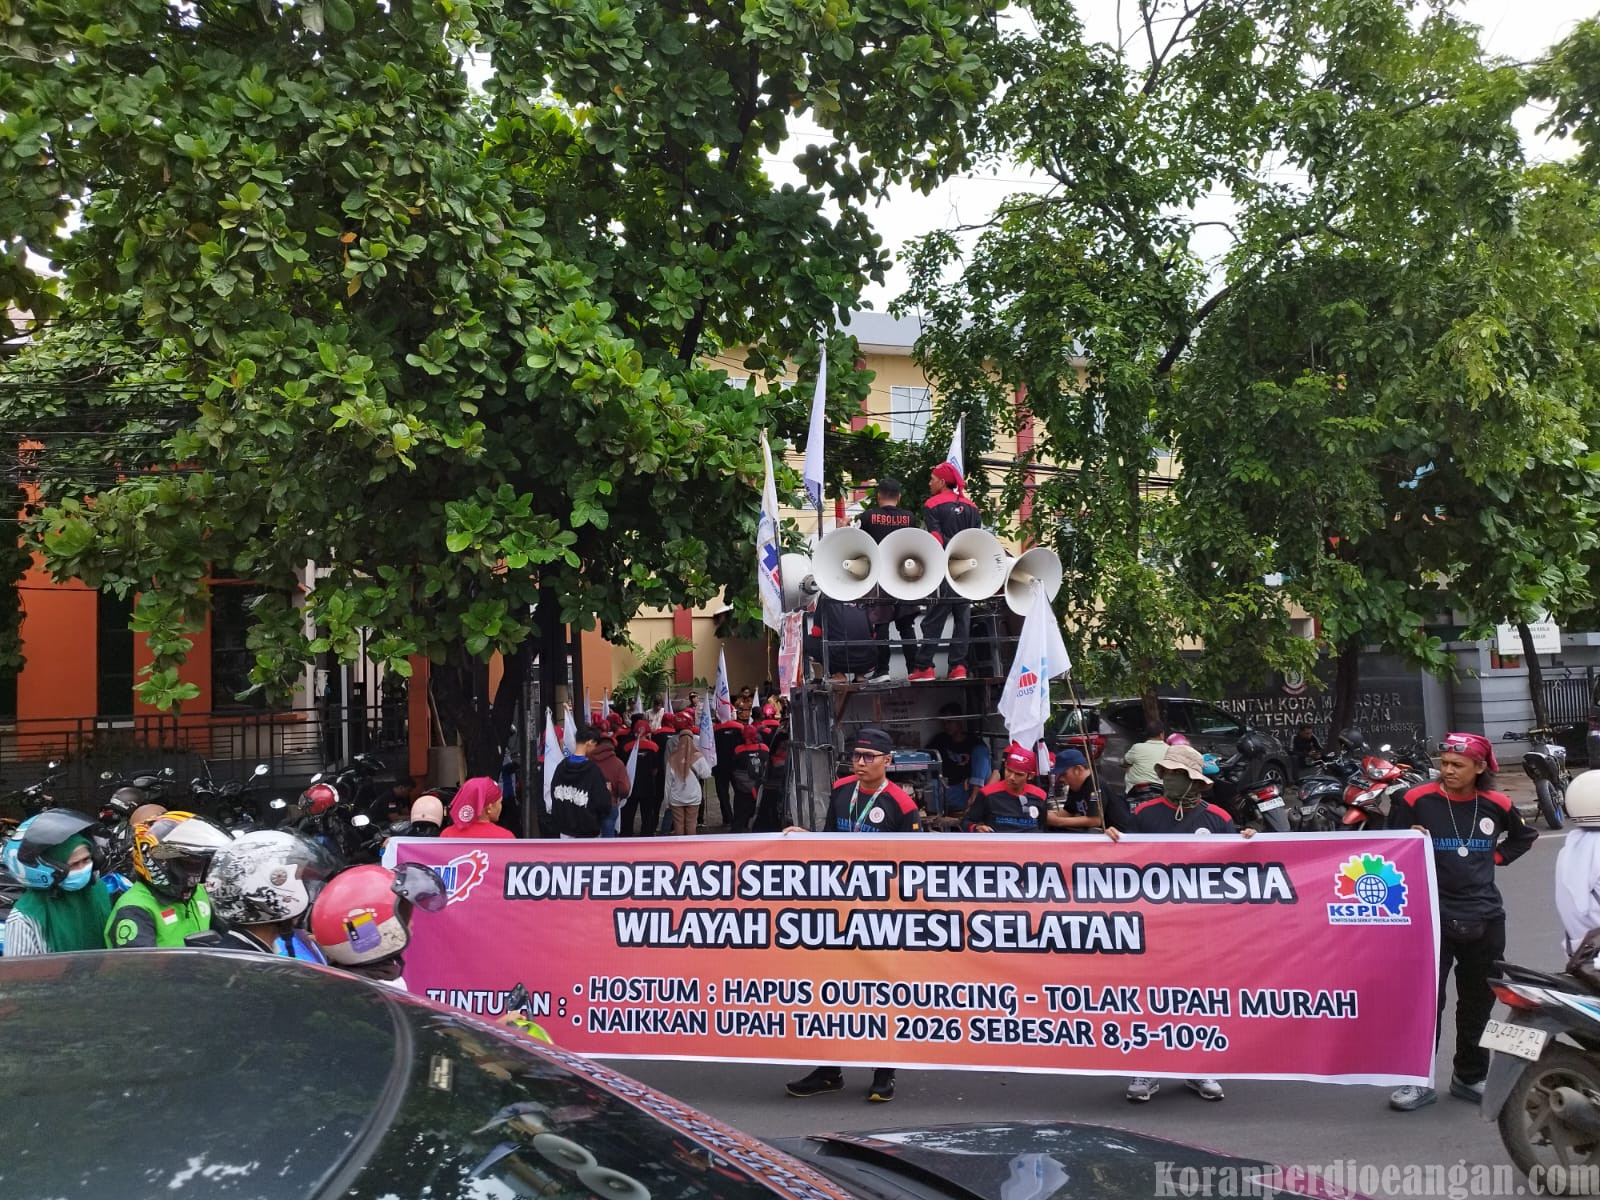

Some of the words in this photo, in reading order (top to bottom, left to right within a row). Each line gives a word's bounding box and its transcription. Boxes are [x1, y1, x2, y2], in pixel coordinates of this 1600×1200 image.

[1278, 697, 1316, 710] KOTA
[506, 864, 732, 897] KONFEDERASI
[740, 864, 894, 897] SERIKAT
[903, 865, 1066, 899] PEKERJA
[1075, 866, 1293, 900] INDONESIA
[1329, 905, 1377, 916] KSPI
[616, 911, 767, 945] WILAYAH
[778, 912, 961, 947] SULAWESI
[970, 914, 1141, 950] SELATAN
[589, 977, 700, 1002] HOSTUM
[723, 979, 812, 1005] HAPUS
[821, 981, 1017, 1016] OUTSOURCING
[1044, 985, 1141, 1014] TOLAK
[1149, 987, 1230, 1016] UPAH
[1241, 989, 1357, 1018] MURAH
[588, 1008, 707, 1034] NAIKKAN
[716, 1011, 785, 1036] UPAH
[793, 1013, 887, 1039] TAHUN
[896, 1017, 962, 1042] 2026
[969, 1017, 1094, 1046] SEBESAR
[1103, 1022, 1229, 1051] 8,5-10%
